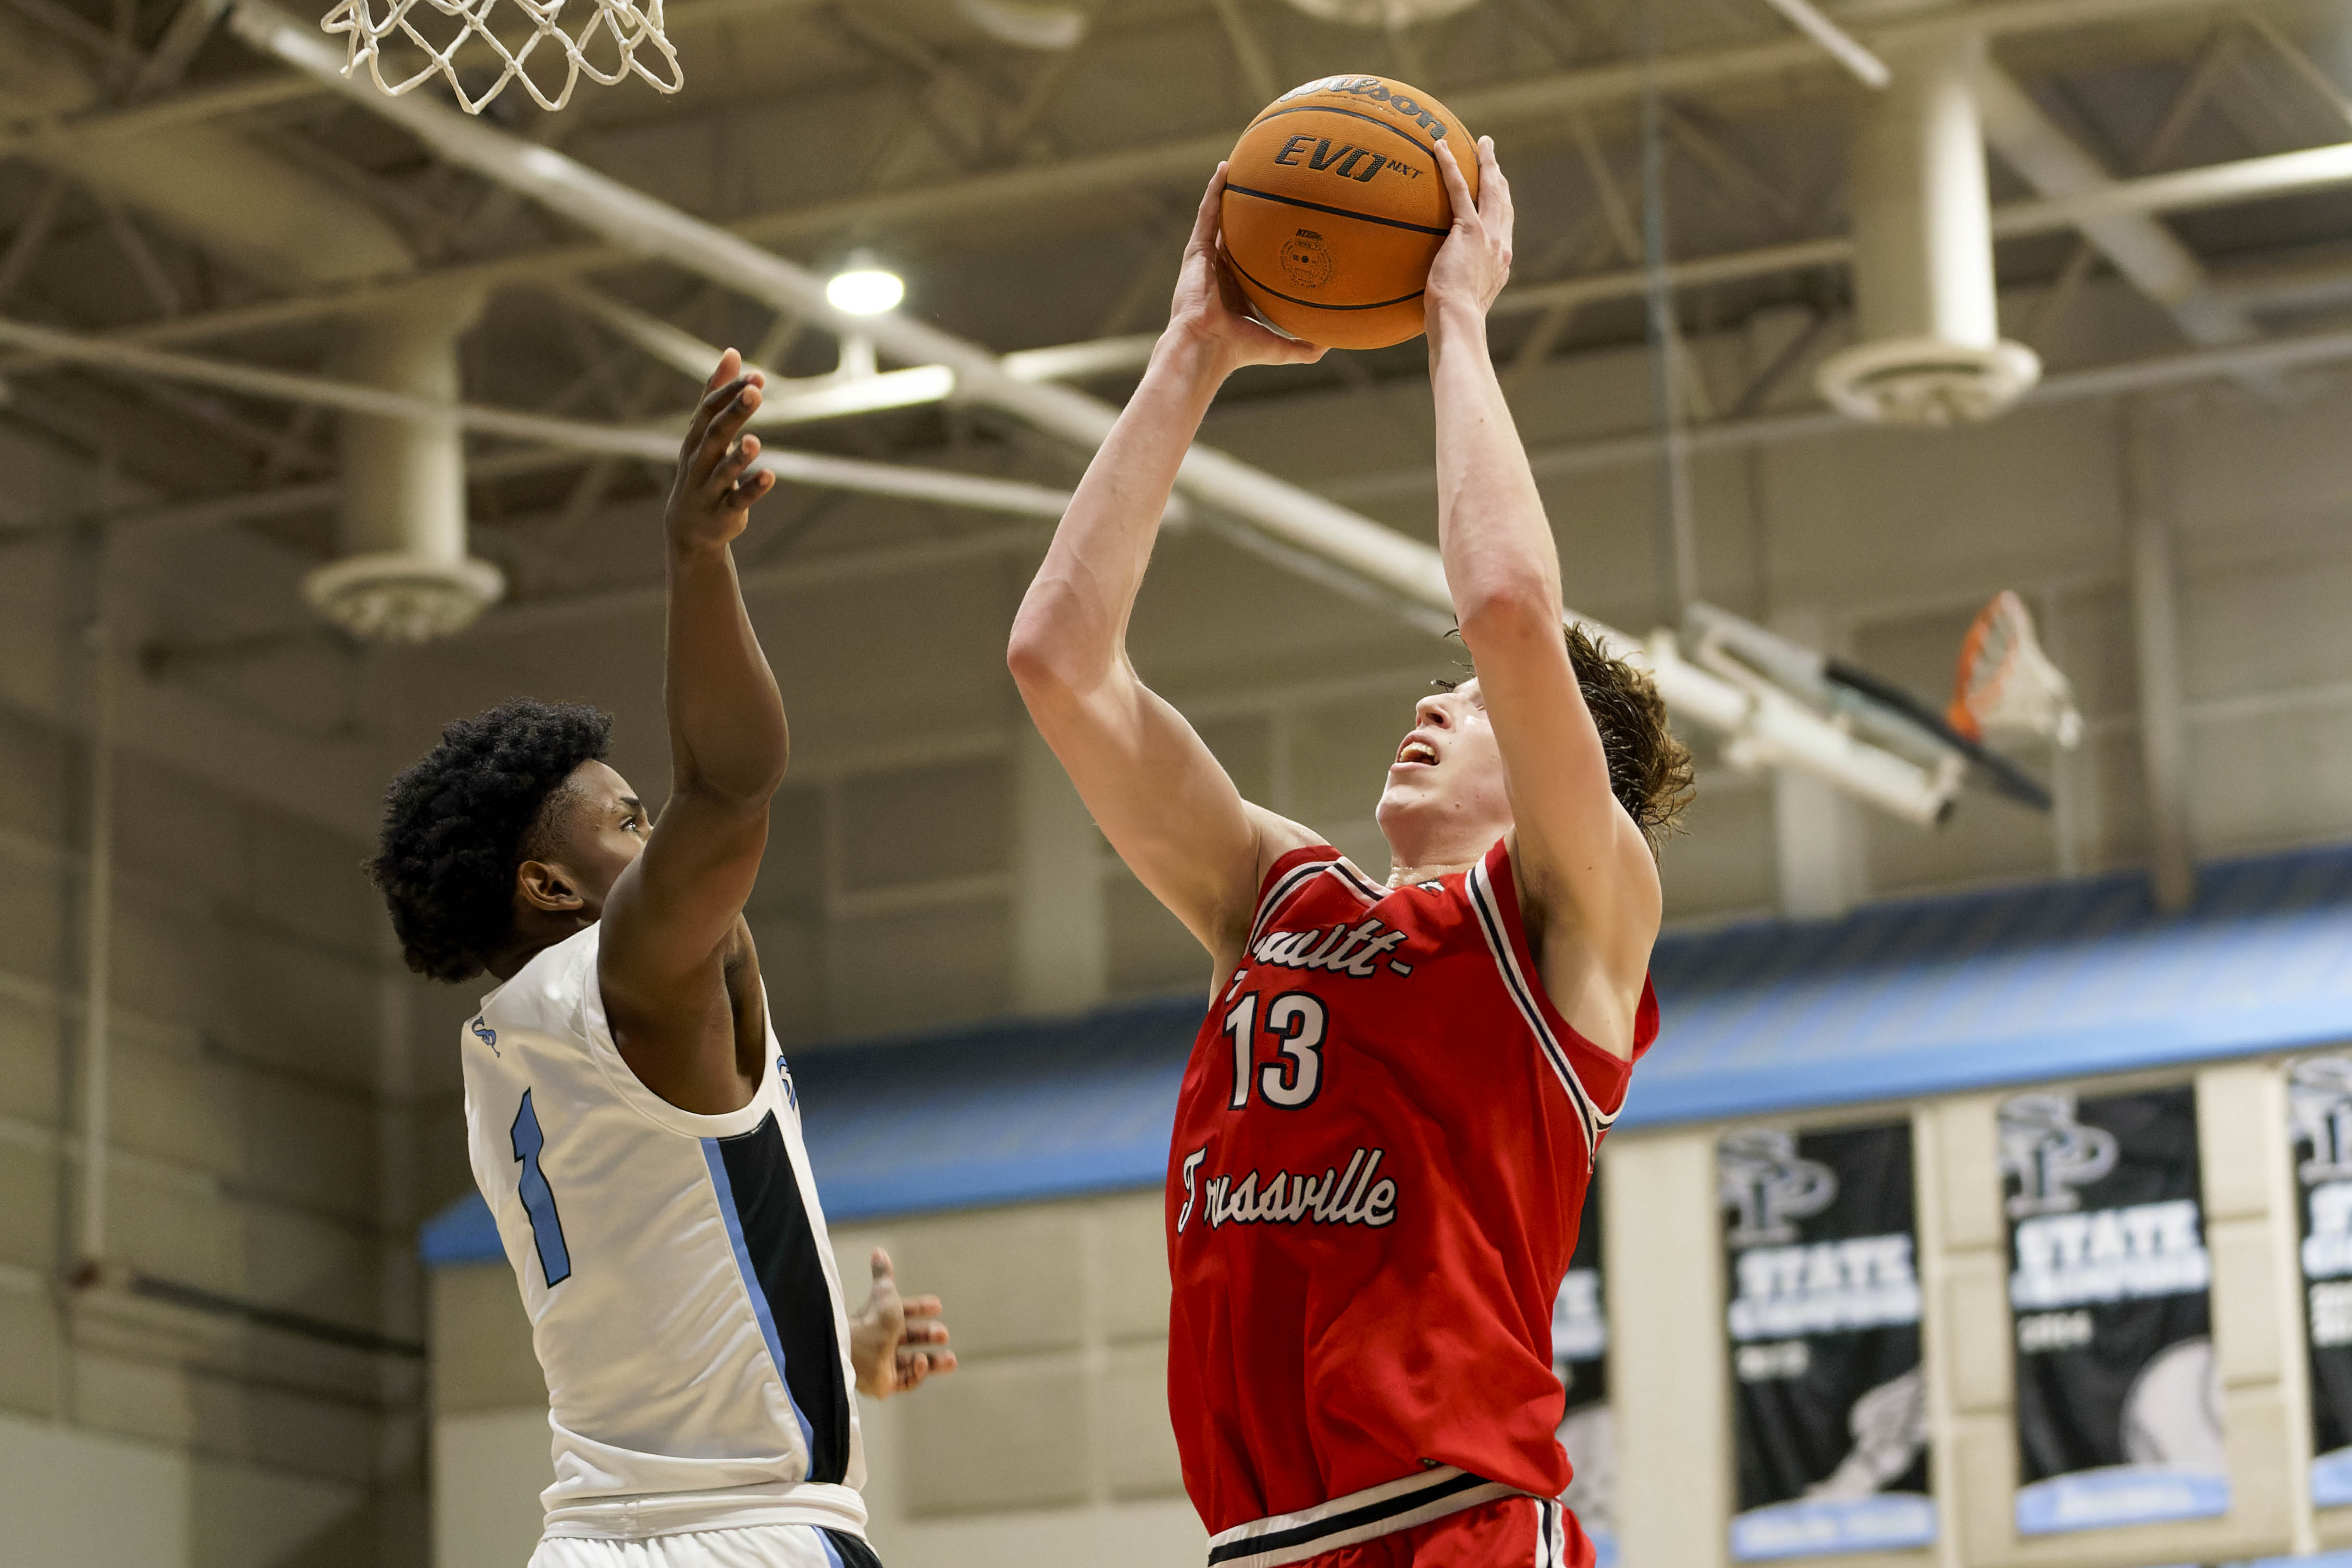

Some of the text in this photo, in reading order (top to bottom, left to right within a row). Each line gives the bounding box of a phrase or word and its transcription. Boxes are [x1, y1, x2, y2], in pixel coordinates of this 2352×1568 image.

[1275, 134, 1423, 182] EVO NXT
[1222, 990, 1329, 1110] 13
[509, 1087, 571, 1290] 1
